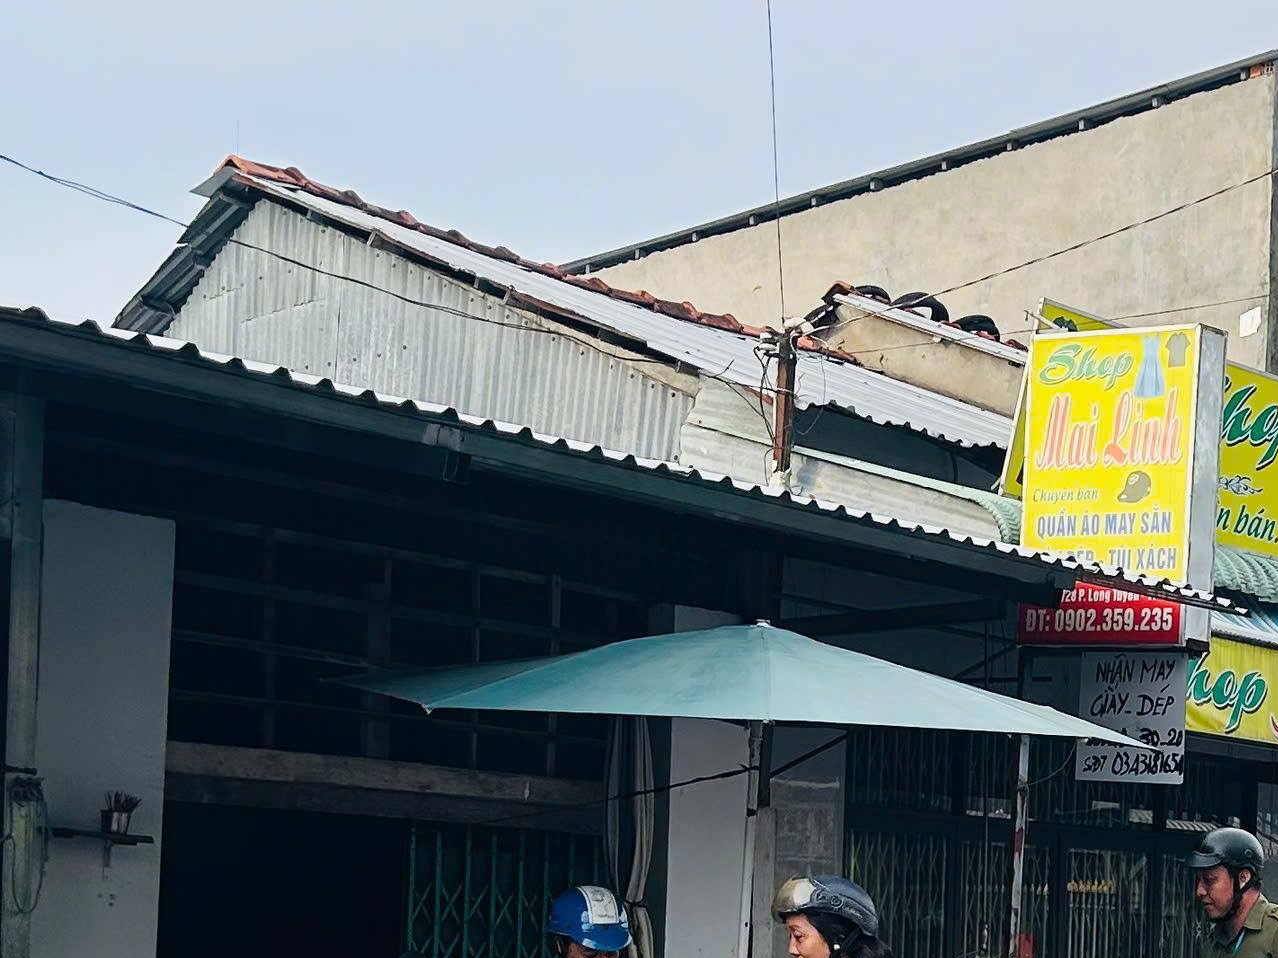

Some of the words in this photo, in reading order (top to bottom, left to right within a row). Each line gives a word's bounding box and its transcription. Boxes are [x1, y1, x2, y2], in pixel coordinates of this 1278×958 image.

[1039, 343, 1135, 390] Shop
[1035, 392, 1099, 470] Mai
[1102, 388, 1183, 466] Linh
[1081, 510, 1100, 536] ÁO
[1105, 512, 1136, 535] MAY
[1136, 544, 1177, 570] XÁCH
[1079, 589, 1087, 602] P.
[1088, 589, 1111, 603] Long
[1026, 610, 1050, 632] ĐT:
[1054, 607, 1174, 632] 0902.359.235
[1140, 658, 1176, 683] MAY
[1136, 684, 1175, 716] DÉP
[1187, 652, 1268, 734] hop
